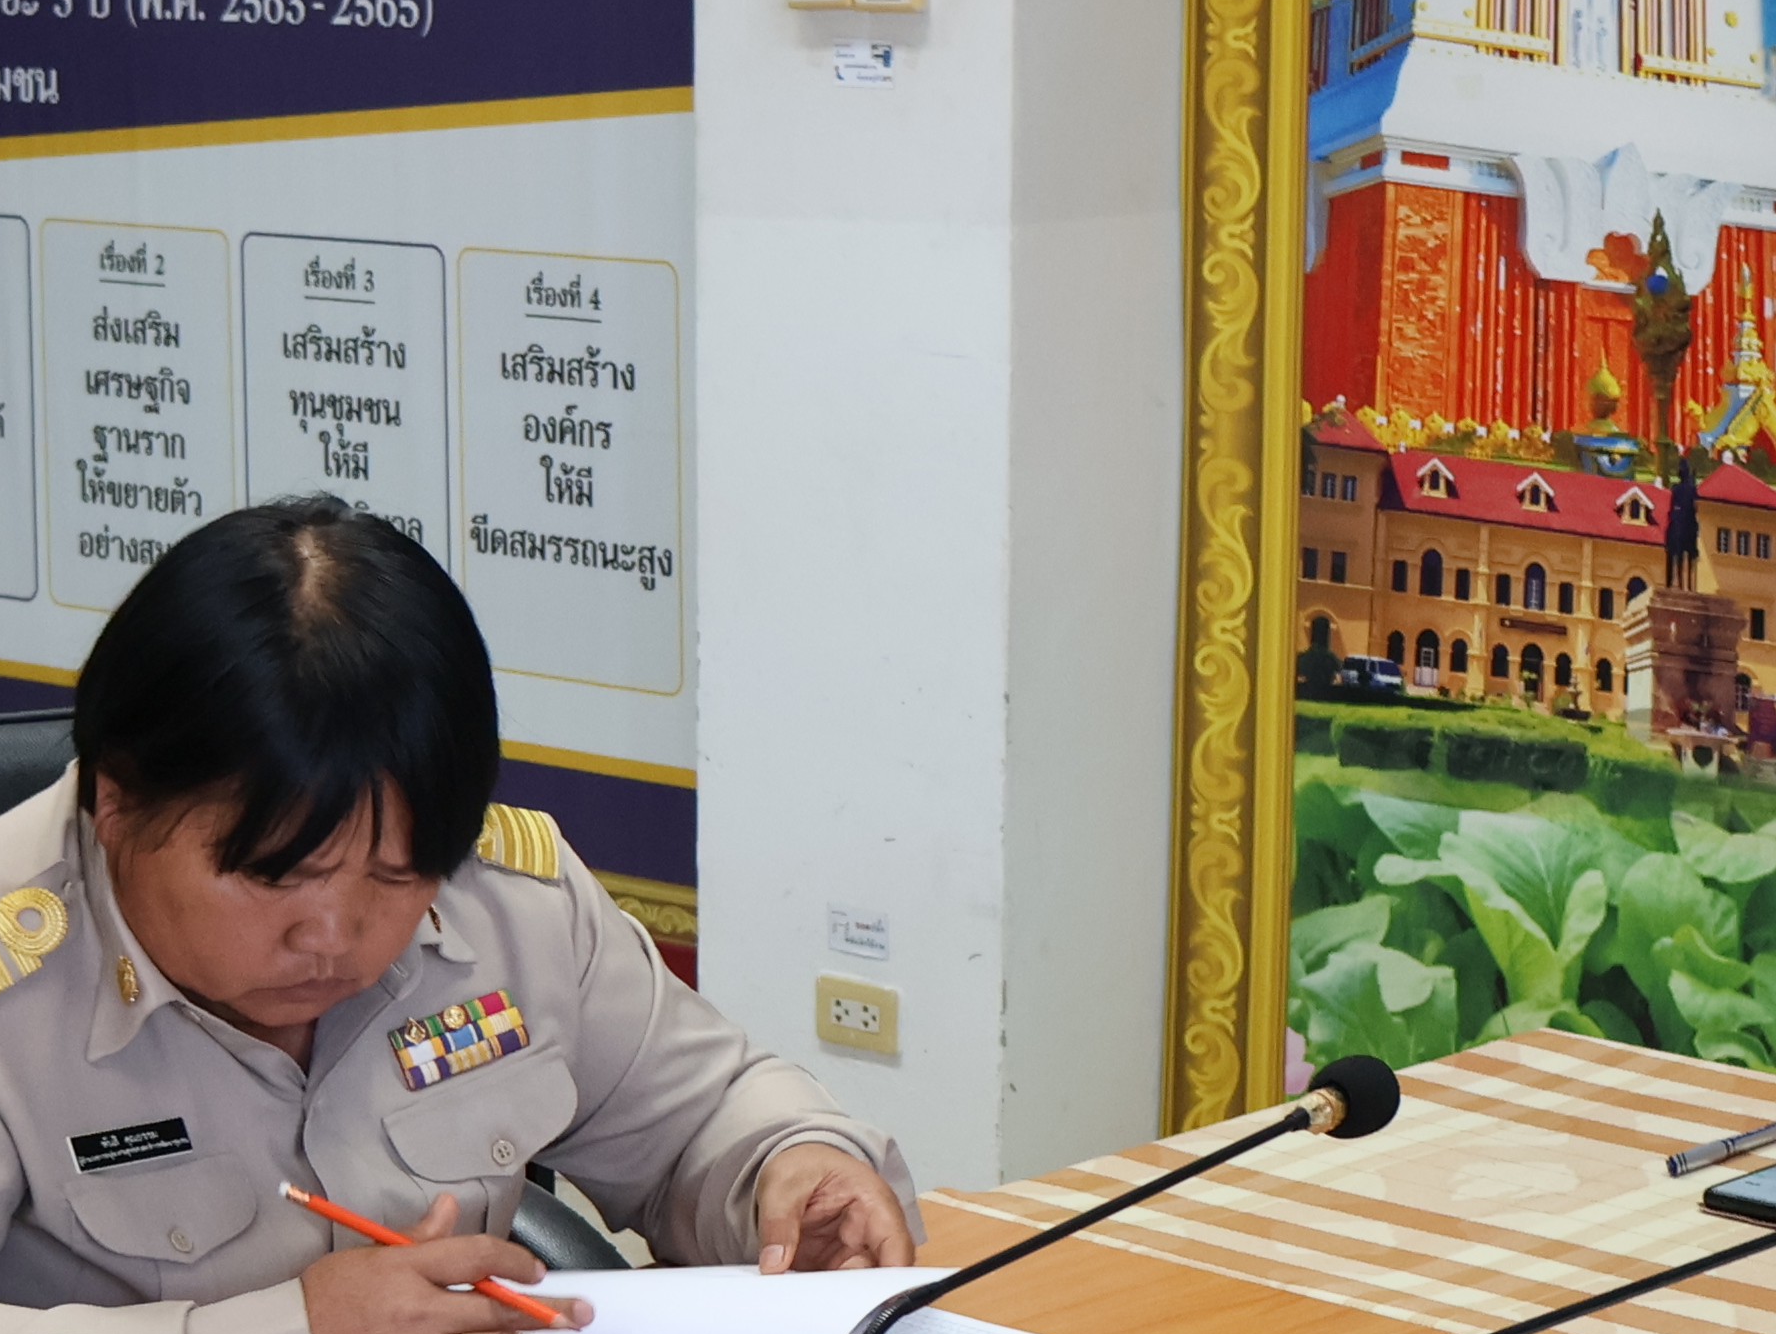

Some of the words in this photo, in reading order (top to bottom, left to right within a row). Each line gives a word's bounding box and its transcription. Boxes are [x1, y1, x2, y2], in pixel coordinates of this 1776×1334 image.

[98, 243, 146, 278] เรื่องที่
[152, 253, 166, 276] 2
[303, 257, 354, 295] เรื่องที่
[360, 270, 375, 293] 3
[524, 274, 578, 314] เรื่องที่
[586, 286, 603, 313] 4
[91, 304, 182, 351] ส่งเสริม
[281, 324, 408, 374] เสริมสร้าง
[84, 365, 192, 418] เศรษฐกิจ
[498, 343, 637, 394] เสริมสร้าง
[288, 386, 403, 435] ทุนชุมชน
[521, 403, 613, 453] องค์กร
[92, 421, 187, 467] ฐานราก
[318, 431, 371, 482] ให้มี
[76, 457, 203, 519] ให้ขยายตัว
[539, 454, 596, 510] ให้มี
[469, 516, 675, 593] ขีดสมรรถนะสูง
